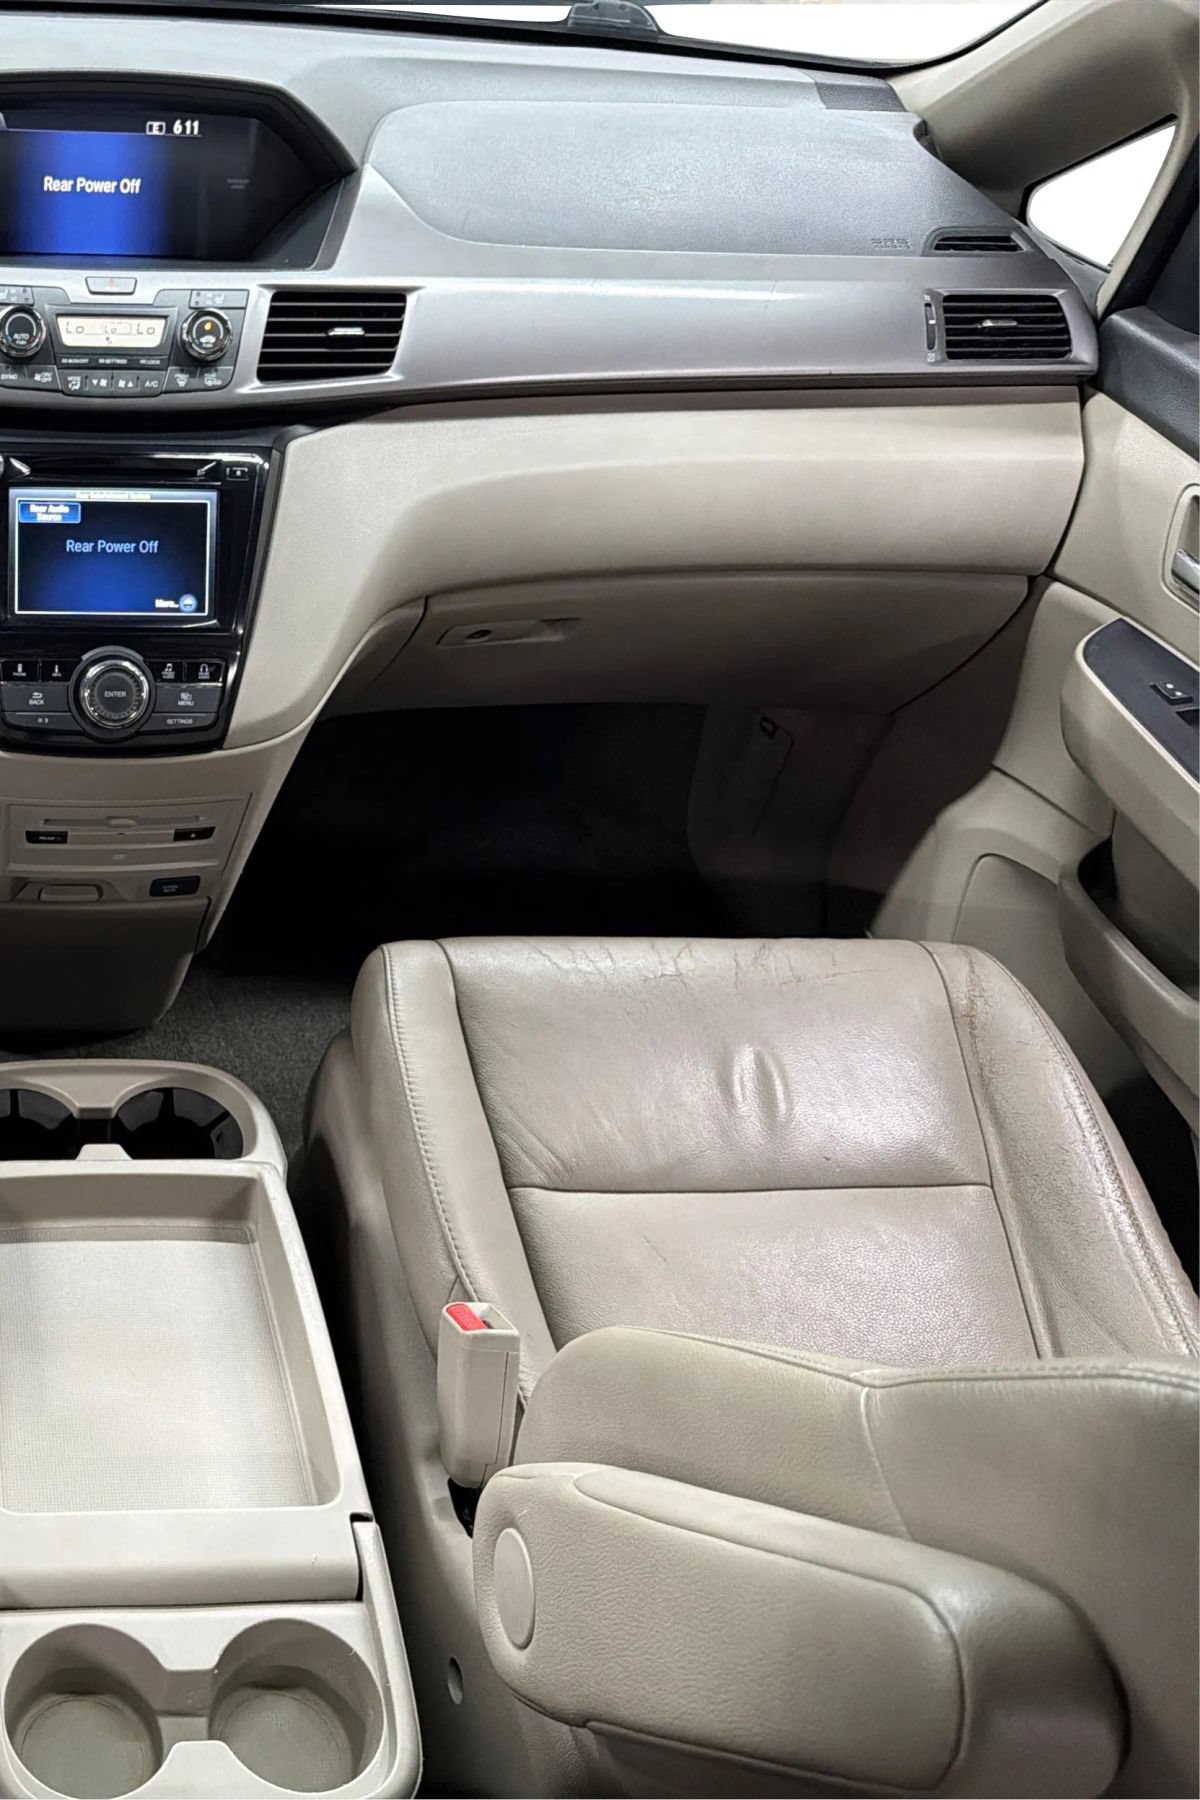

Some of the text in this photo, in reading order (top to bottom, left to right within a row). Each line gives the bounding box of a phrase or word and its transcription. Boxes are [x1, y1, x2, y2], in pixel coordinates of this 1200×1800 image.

[173, 119, 199, 136] 611
[43, 175, 142, 194] Rear Power Off
[65, 321, 84, 334] Lo
[136, 322, 155, 335] Lo
[144, 380, 159, 388] A/C
[66, 539, 159, 553] Rear Power Off
